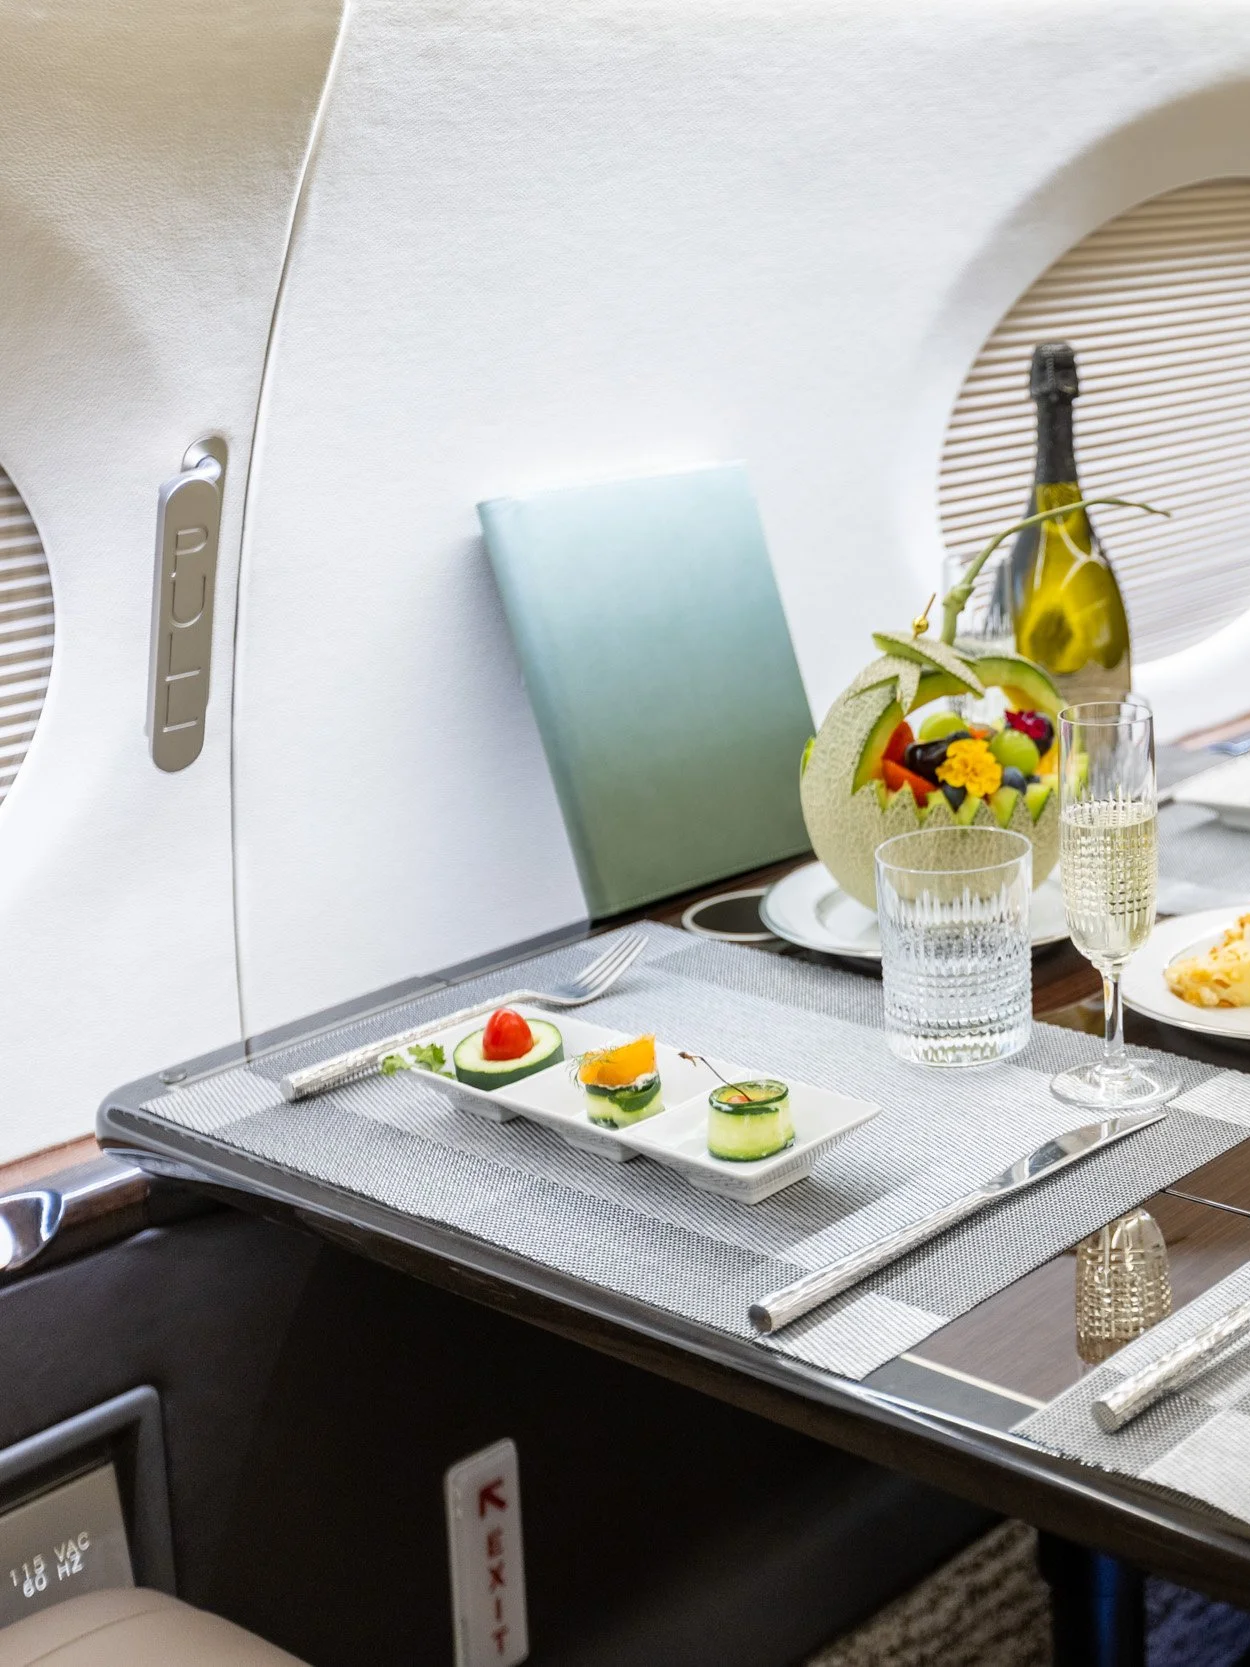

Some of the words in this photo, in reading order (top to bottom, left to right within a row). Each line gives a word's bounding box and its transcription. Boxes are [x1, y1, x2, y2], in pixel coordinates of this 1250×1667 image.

[163, 528, 209, 733] PULL
[11, 1554, 45, 1586] 115
[54, 1531, 90, 1562] VAC
[23, 1573, 47, 1598] 60
[486, 1525, 509, 1656] EXIT
